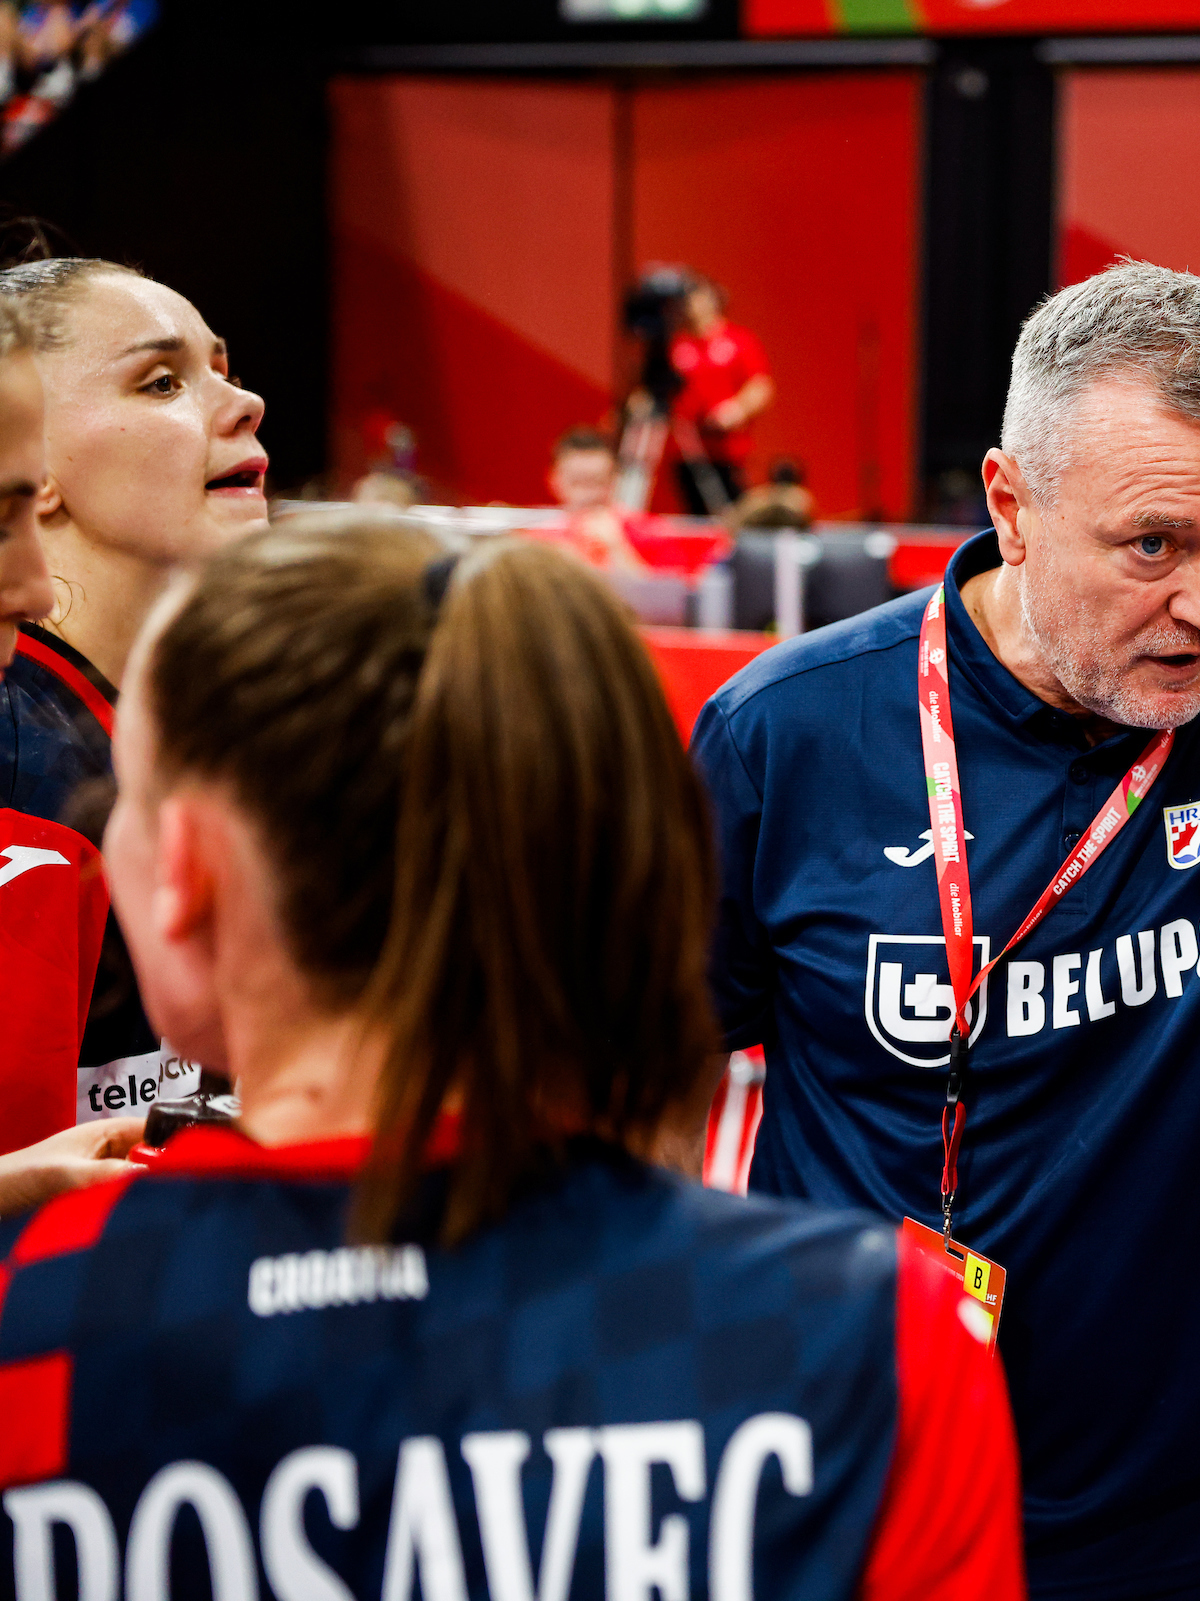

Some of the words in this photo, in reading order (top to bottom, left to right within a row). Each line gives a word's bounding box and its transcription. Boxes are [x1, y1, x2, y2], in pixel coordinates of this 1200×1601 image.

[933, 762, 953, 800] CATCH
[937, 801, 956, 824] THE
[940, 826, 960, 863] SPIRIT
[1053, 859, 1083, 896] CATCH
[1077, 839, 1098, 863] THE
[1091, 806, 1122, 844] SPIRIT
[951, 897, 963, 937] Mobiliar
[974, 1267, 983, 1289] B
